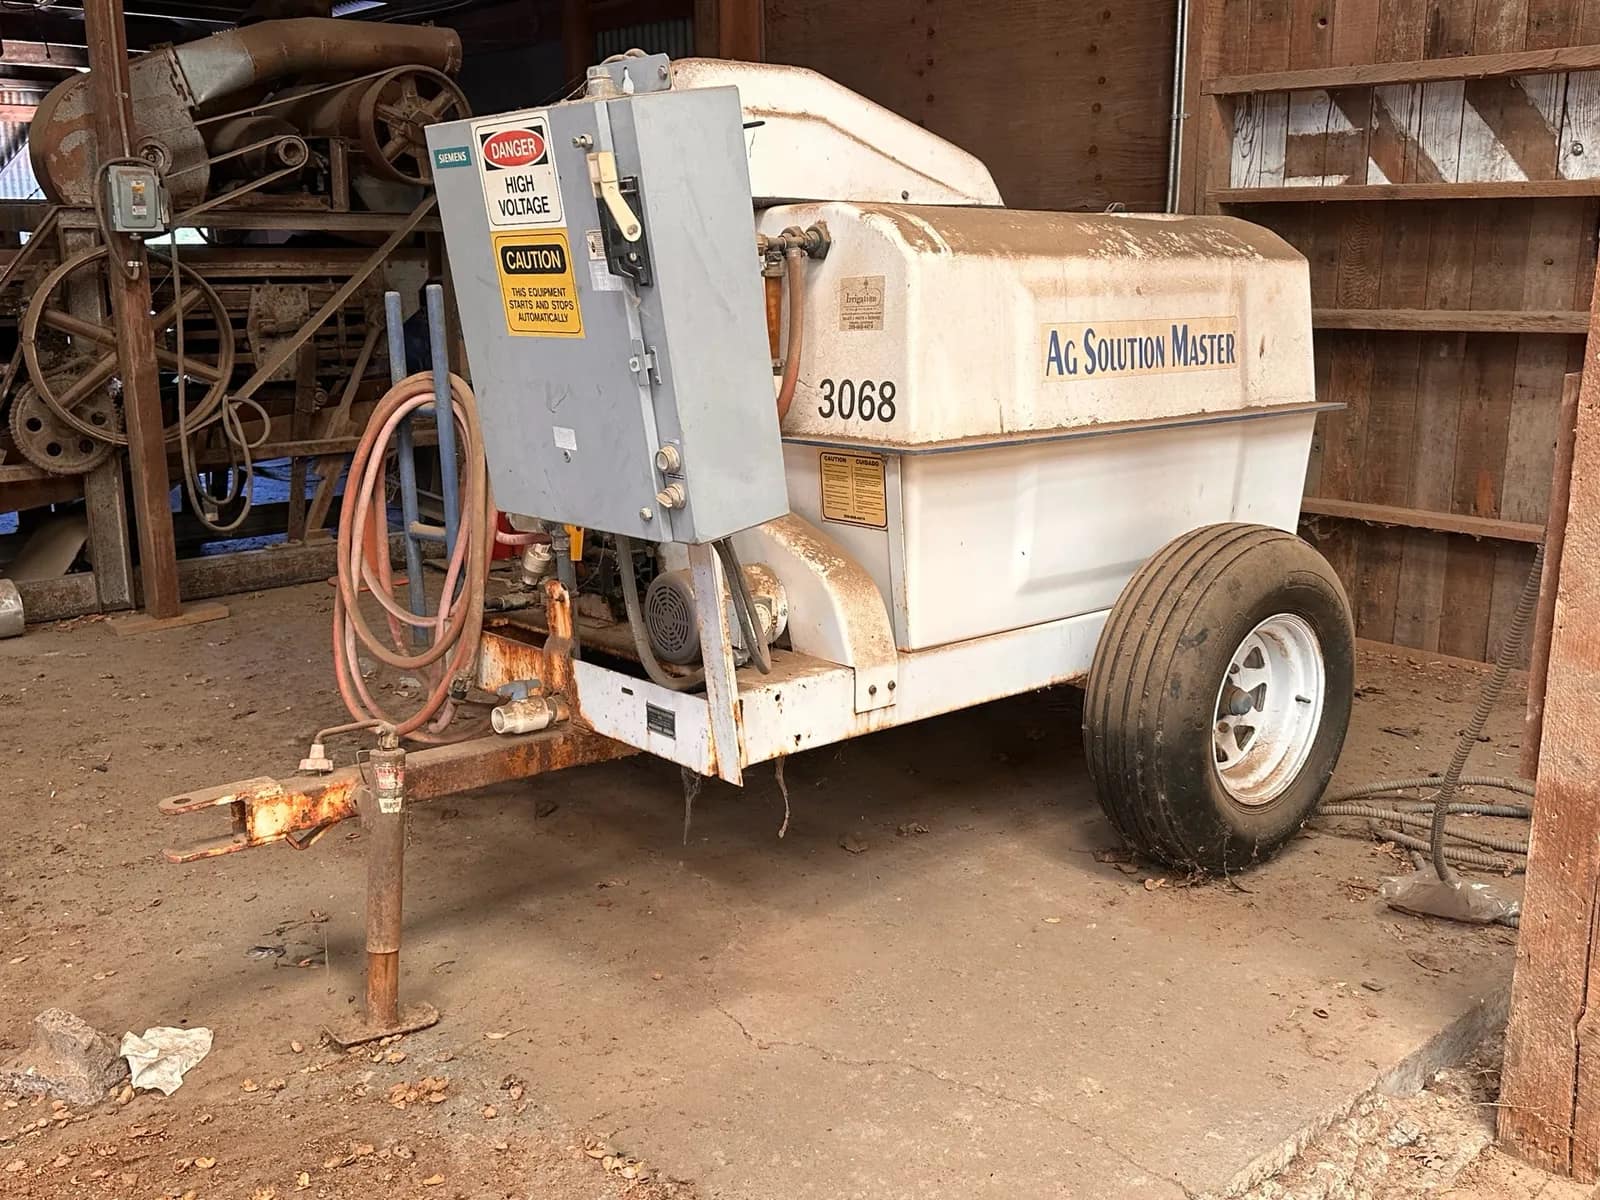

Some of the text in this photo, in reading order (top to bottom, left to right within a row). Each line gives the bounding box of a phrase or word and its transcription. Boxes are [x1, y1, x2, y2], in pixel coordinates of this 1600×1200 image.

[490, 138, 537, 159] DANGER
[438, 151, 467, 164] SIEMENS
[505, 175, 535, 194] HIGH
[498, 196, 550, 217] VOLTAGE
[506, 250, 562, 269] CAUTION
[511, 287, 566, 297] THIS EQUIPMENT
[508, 299, 575, 311] STARTS AND STOPS
[518, 312, 569, 323] AUTOMATICALLY
[818, 378, 896, 423] 3068
[823, 455, 847, 464] CAUTION
